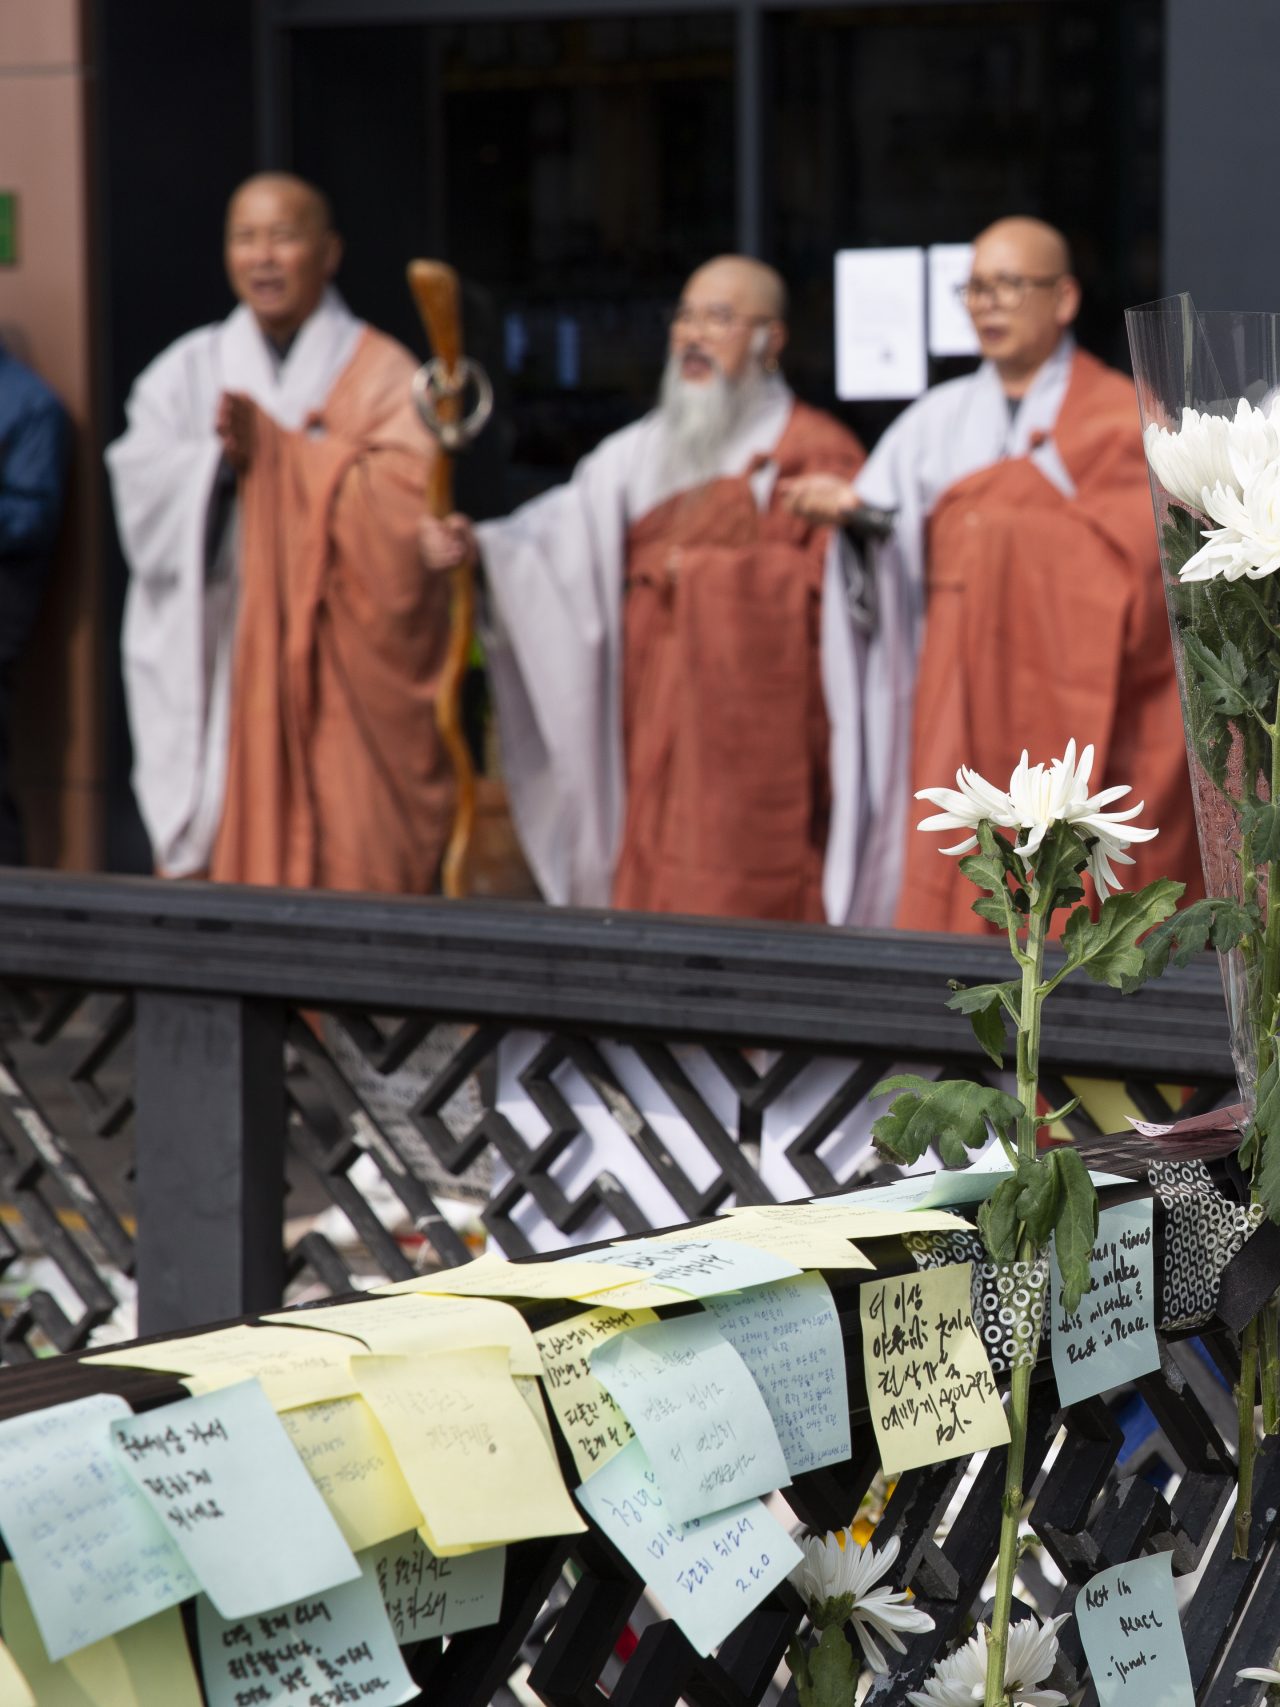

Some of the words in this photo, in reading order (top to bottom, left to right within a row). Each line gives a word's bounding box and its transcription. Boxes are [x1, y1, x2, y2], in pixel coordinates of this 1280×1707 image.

[1120, 1226, 1150, 1250] times
[1066, 1335, 1097, 1365] Rest
[1102, 1330, 1113, 1347] in
